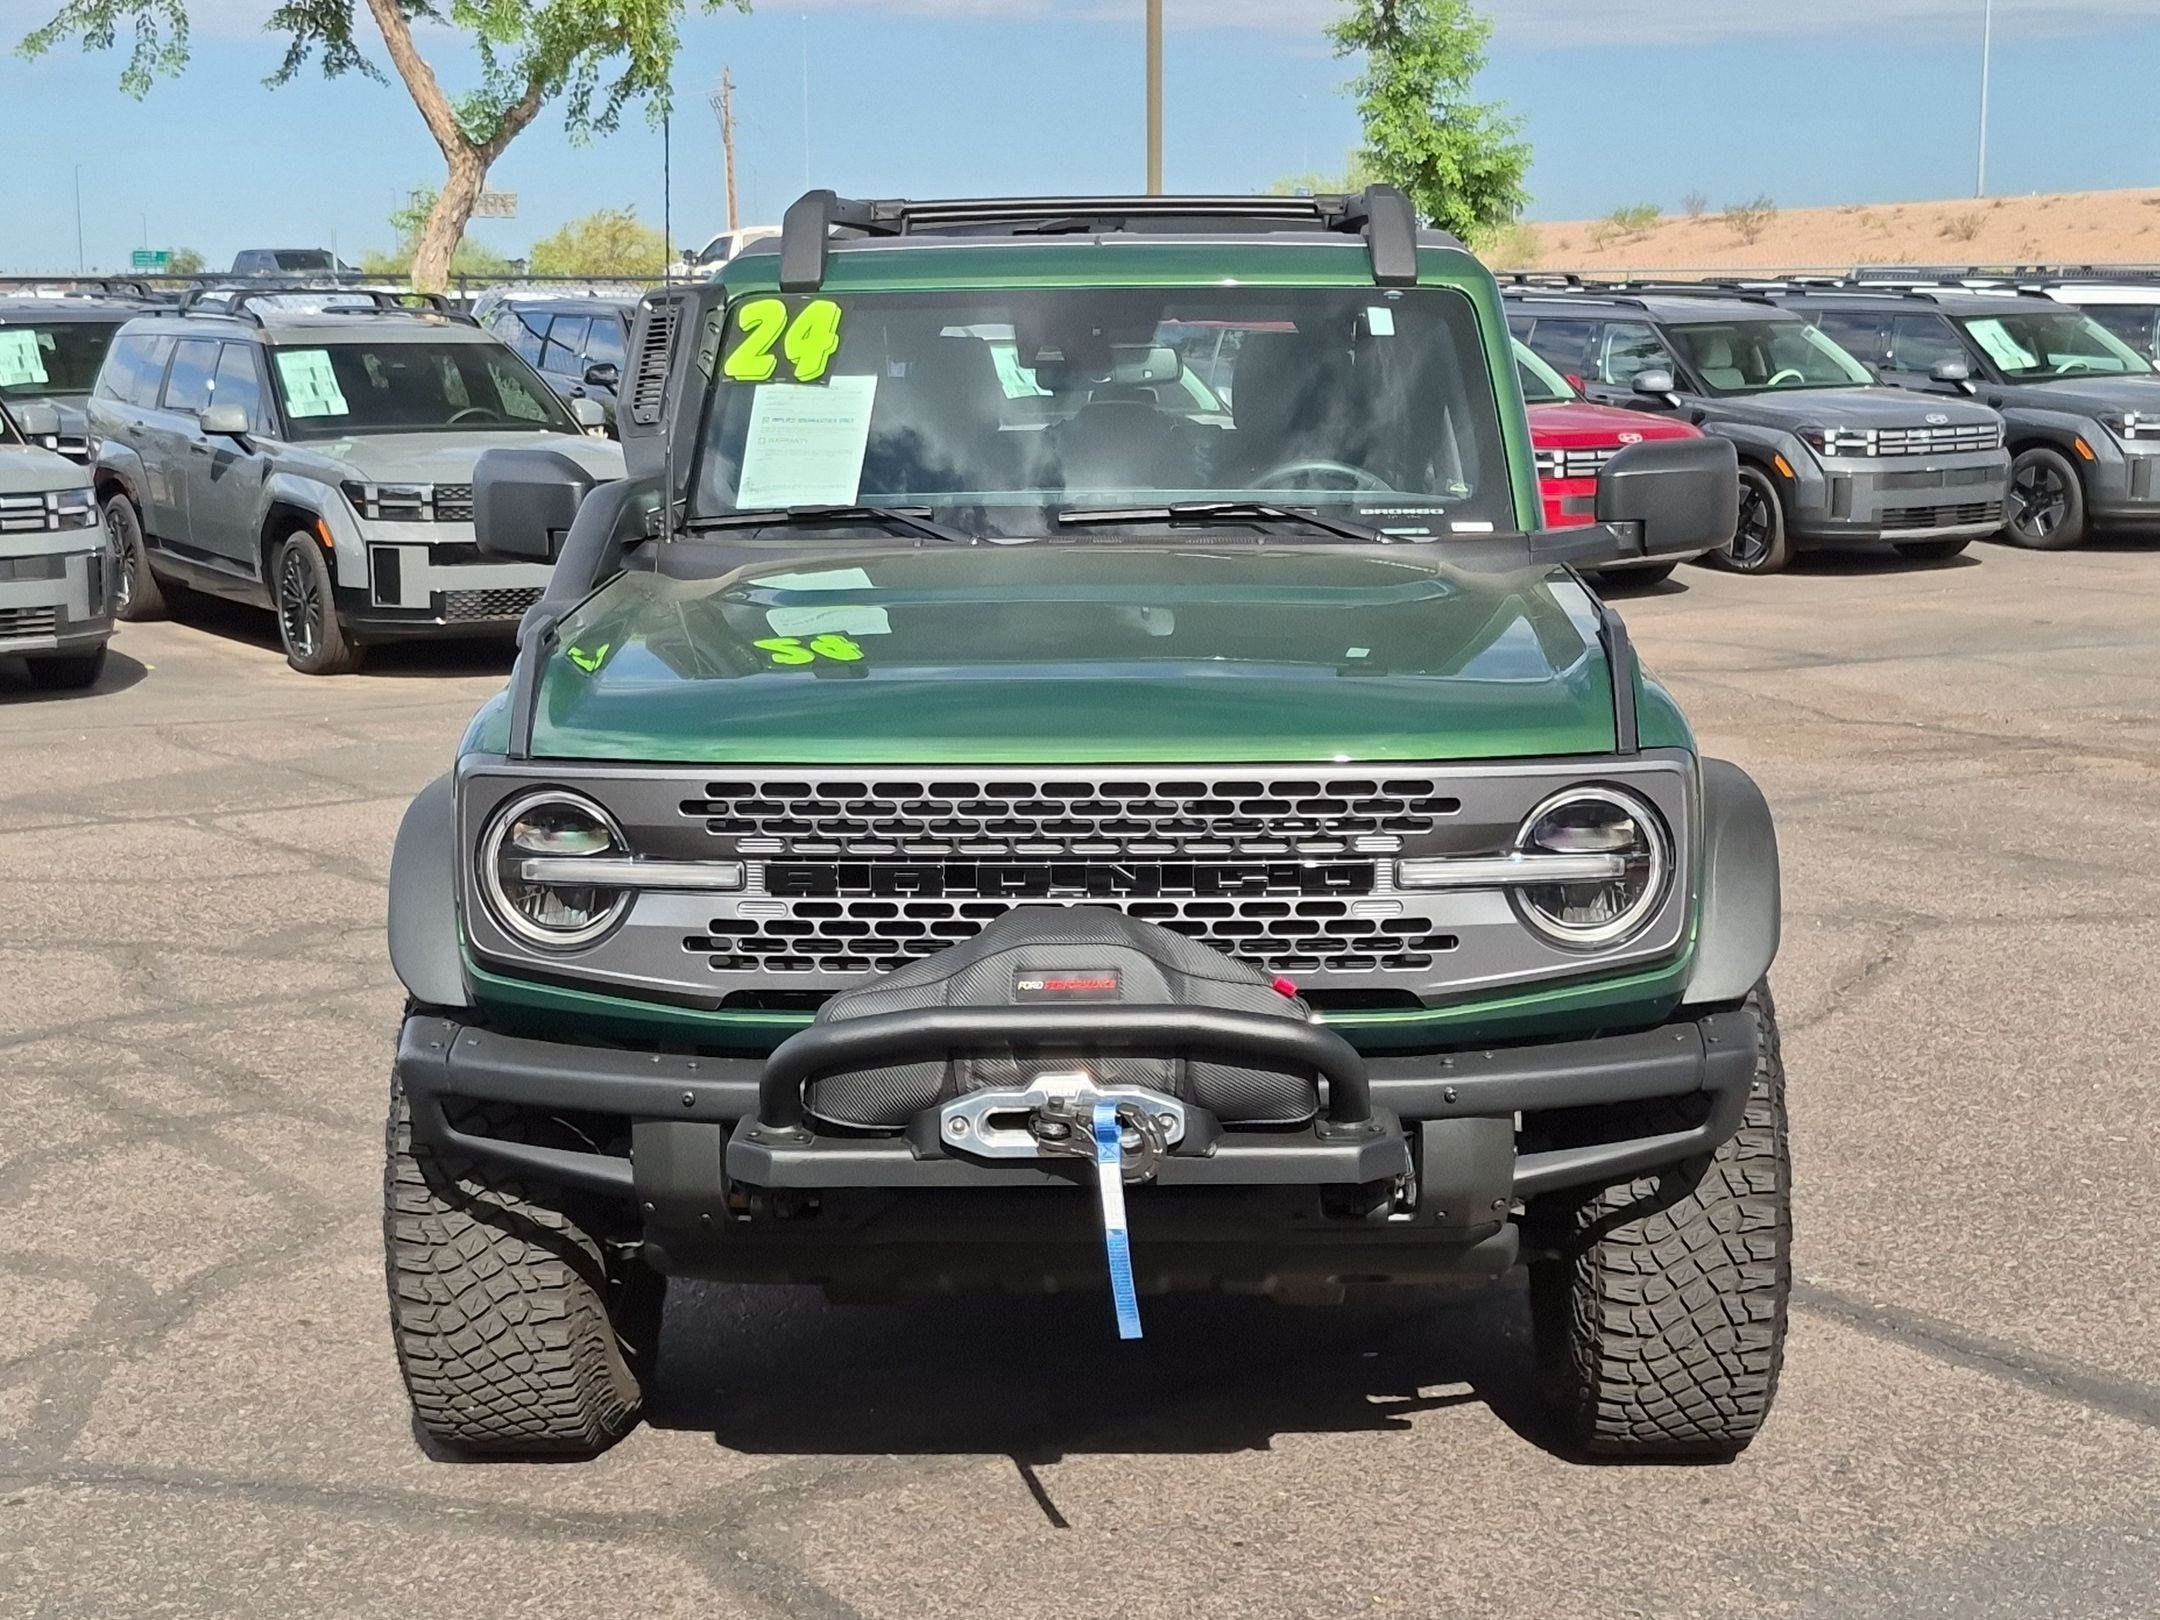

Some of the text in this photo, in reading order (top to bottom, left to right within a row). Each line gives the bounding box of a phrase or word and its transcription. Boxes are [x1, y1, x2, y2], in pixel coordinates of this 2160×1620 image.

[724, 298, 842, 382] 24
[766, 862, 1373, 896] BRONCO
[1017, 980, 1044, 990] FORD
